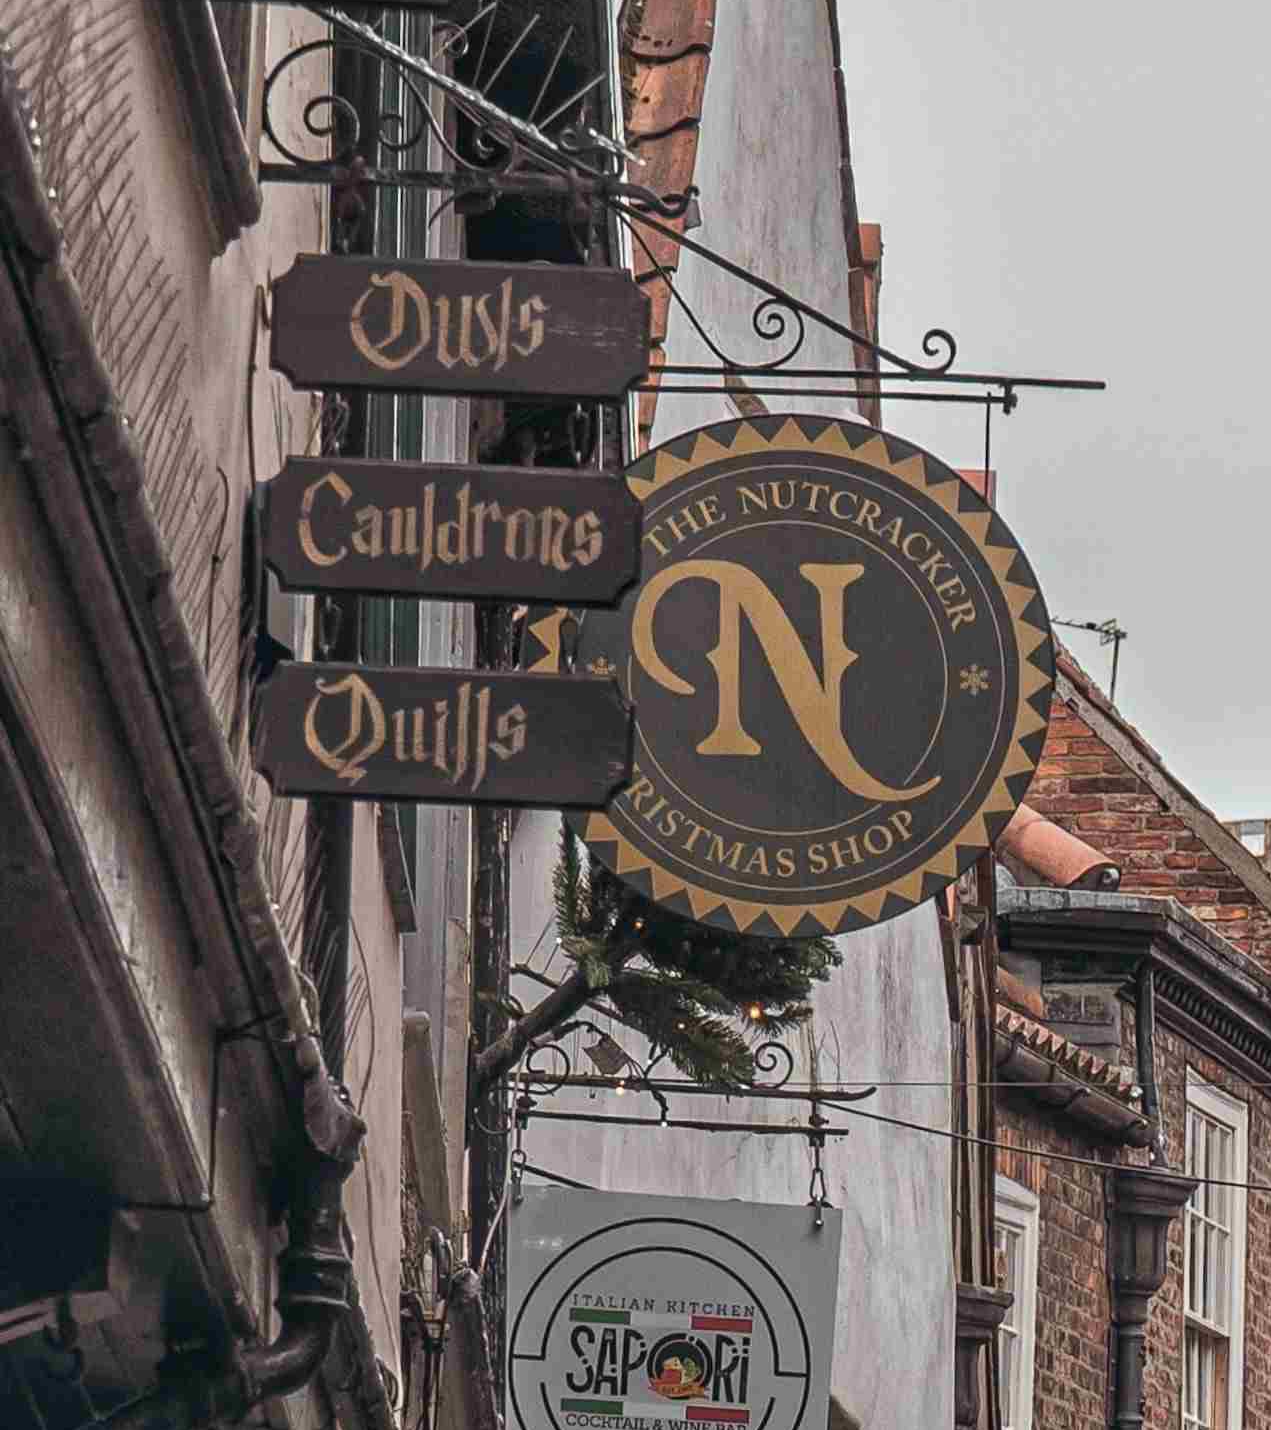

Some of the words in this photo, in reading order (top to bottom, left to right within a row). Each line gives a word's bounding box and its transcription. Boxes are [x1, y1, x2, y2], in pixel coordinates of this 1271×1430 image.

[350, 271, 551, 371] Owls
[299, 472, 604, 570] Cauldrons
[642, 495, 728, 560] THE
[735, 481, 977, 635] NUTCRACKER
[632, 558, 943, 802] N
[305, 673, 528, 793] Quills
[622, 775, 797, 879] RISTMAS
[807, 809, 915, 875] SHOP
[573, 1294, 656, 1314] ITALIAN
[667, 1300, 756, 1317] KITCHEN
[566, 1324, 751, 1404] SAPORI
